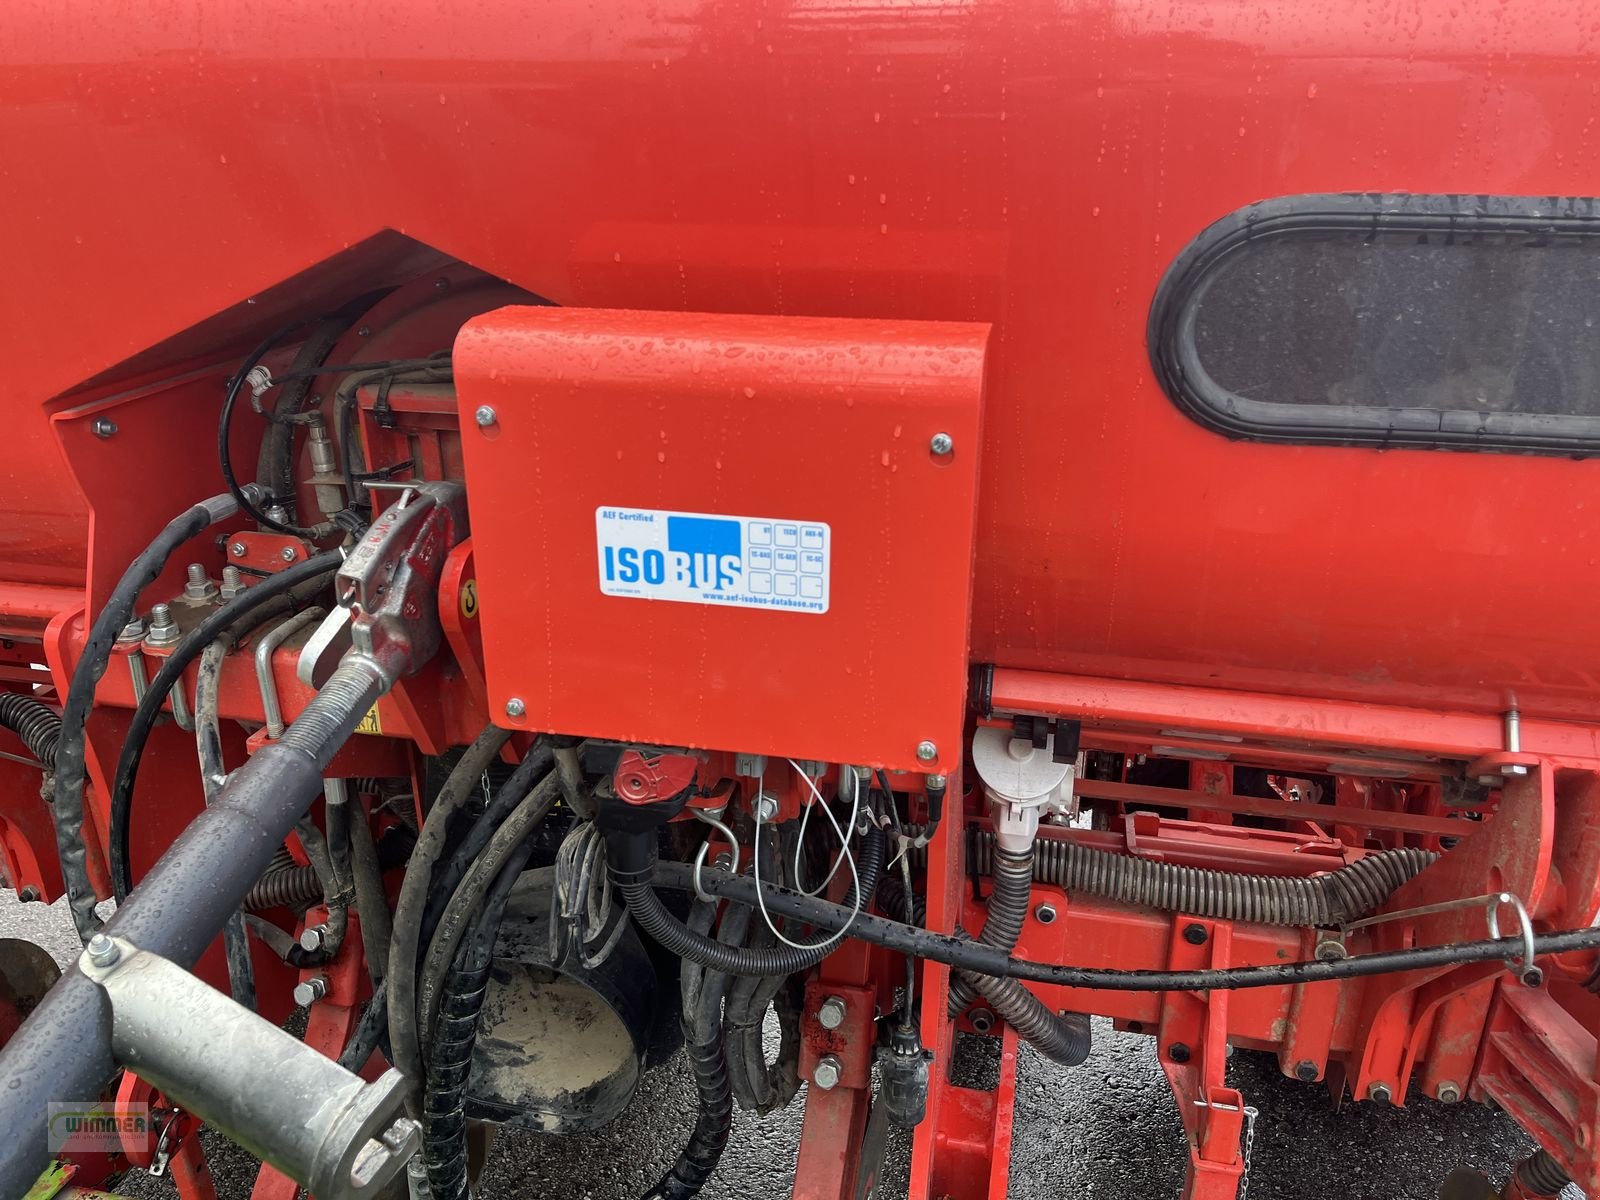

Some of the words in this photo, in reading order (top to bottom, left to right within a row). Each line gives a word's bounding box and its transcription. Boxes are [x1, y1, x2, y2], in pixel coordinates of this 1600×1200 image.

[602, 510, 616, 520] AEF
[619, 511, 654, 522] Certified
[702, 592, 824, 611] www.aef-isobus-database.org
